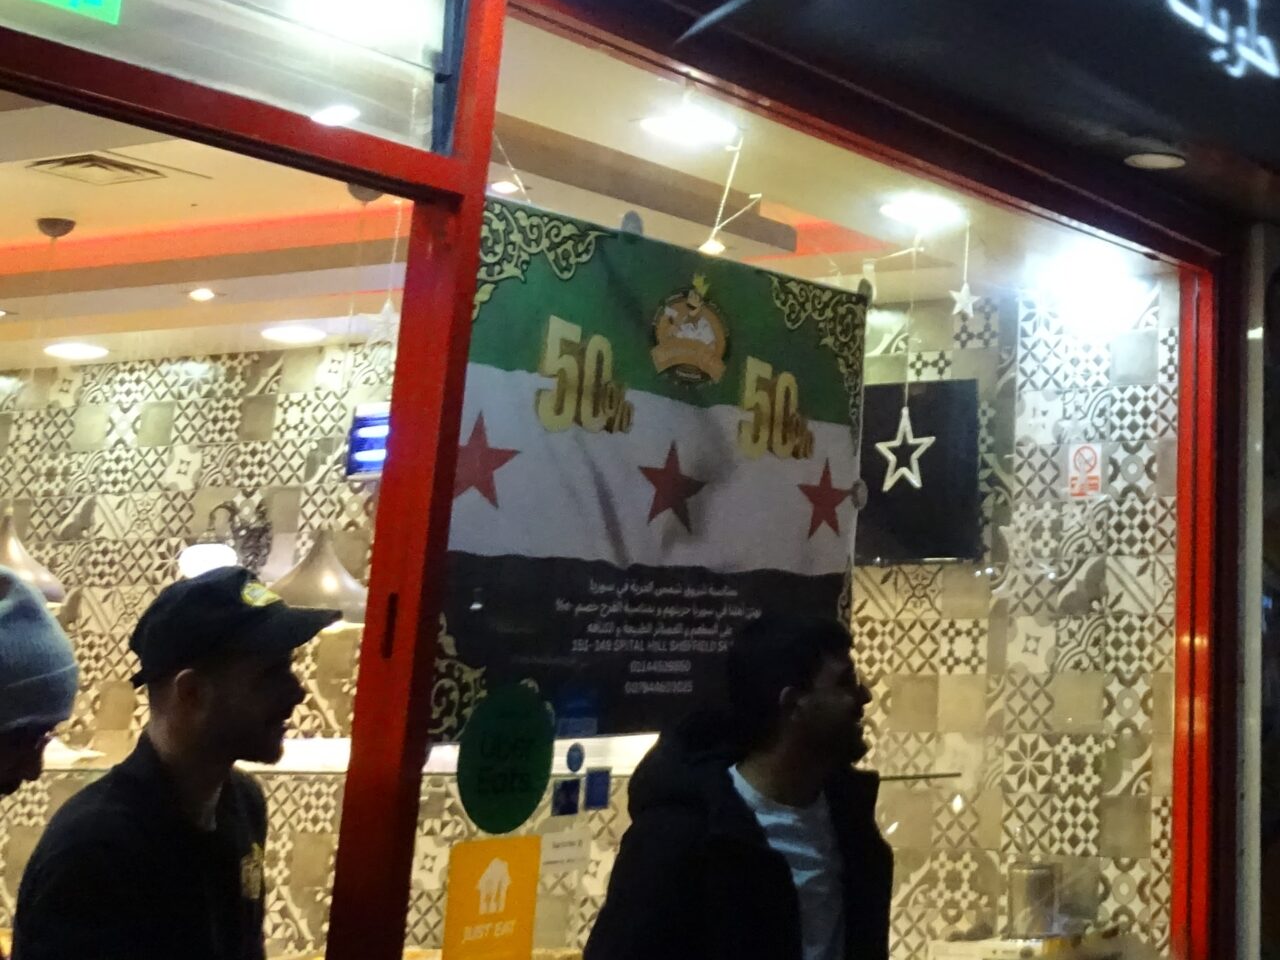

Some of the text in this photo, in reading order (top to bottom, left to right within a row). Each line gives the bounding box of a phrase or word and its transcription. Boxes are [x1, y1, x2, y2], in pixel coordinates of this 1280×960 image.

[534, 314, 635, 434] 50%
[737, 355, 815, 462] 50%
[477, 766, 533, 795] Eats
[480, 732, 536, 761] Uber
